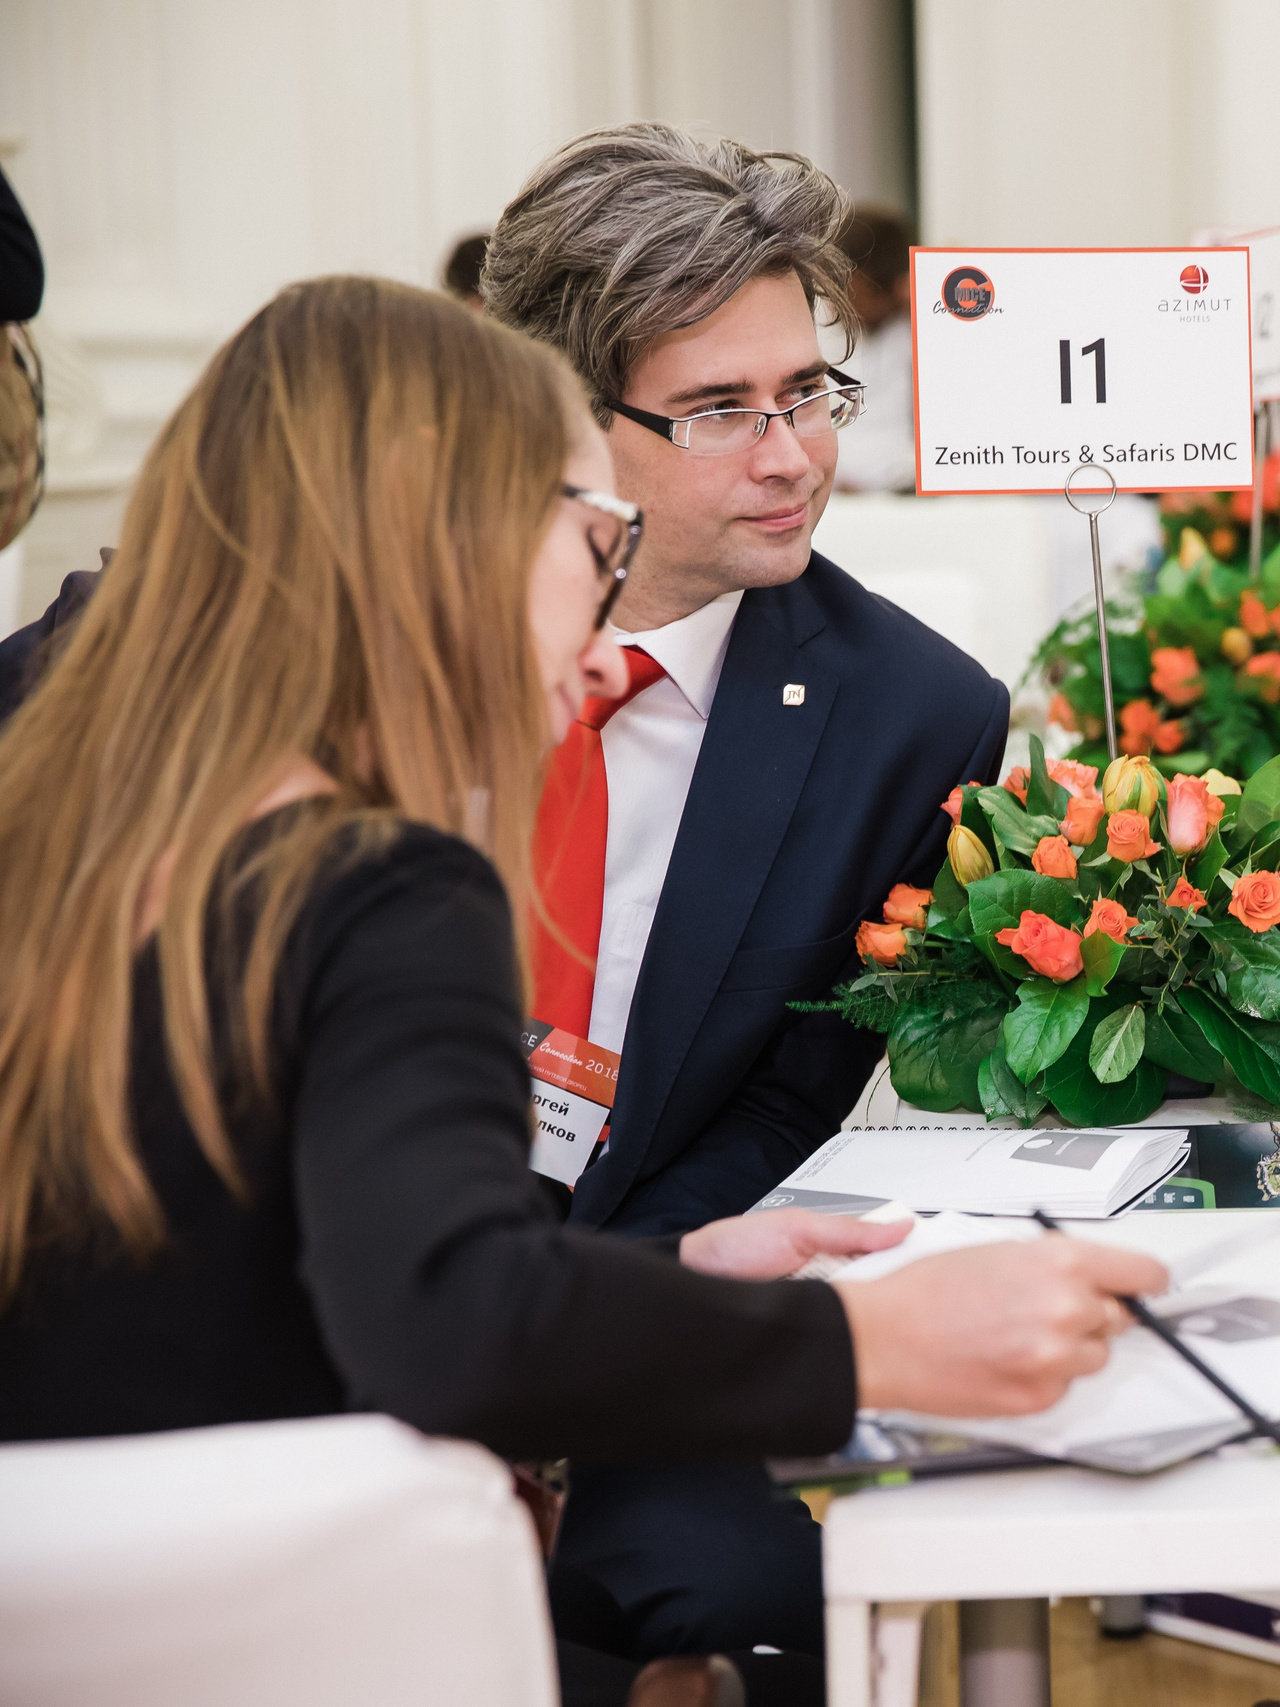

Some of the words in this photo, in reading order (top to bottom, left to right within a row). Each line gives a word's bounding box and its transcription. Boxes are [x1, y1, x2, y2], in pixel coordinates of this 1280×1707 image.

[954, 286, 986, 302] MICE
[932, 300, 1004, 315] Connection
[1179, 315, 1211, 323] HOTELS
[935, 446, 1004, 465] Zenith
[1012, 445, 1070, 464] Tours
[1078, 444, 1094, 463] &
[1103, 442, 1175, 462] Safaris
[1184, 442, 1238, 462] DMC
[520, 1031, 538, 1048] CE
[540, 1042, 583, 1066] Connection
[585, 1059, 619, 1081] 2018
[533, 1094, 570, 1116] ргей
[538, 1120, 576, 1142] лков
